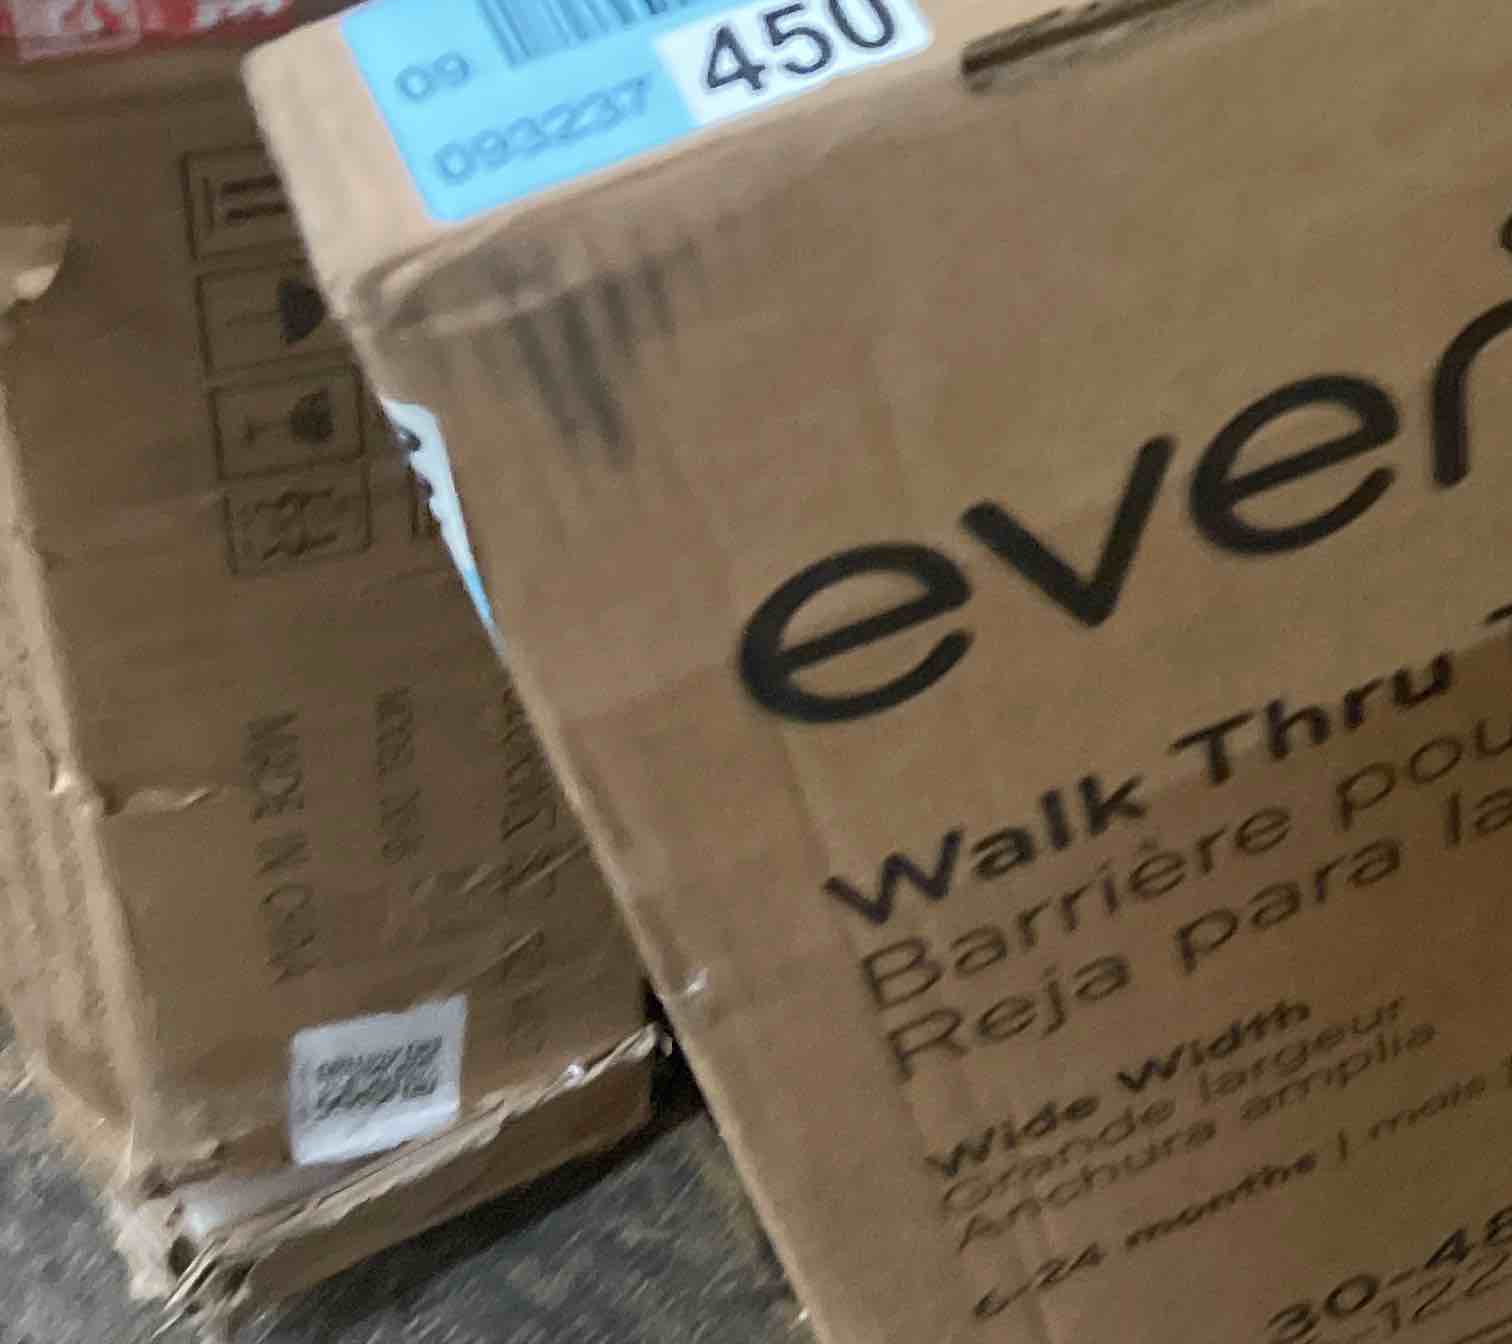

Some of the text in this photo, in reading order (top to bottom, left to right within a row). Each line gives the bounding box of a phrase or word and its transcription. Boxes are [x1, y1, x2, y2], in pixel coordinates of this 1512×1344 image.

[395, 49, 470, 103] 09
[432, 71, 654, 185] 093237
[822, 770, 1149, 926] Walk
[1169, 646, 1457, 787] Thru
[860, 804, 1297, 1012] Barrière
[885, 950, 1132, 1084] Reja
[1172, 834, 1406, 977] para
[923, 999, 1312, 1178] Wide Width
